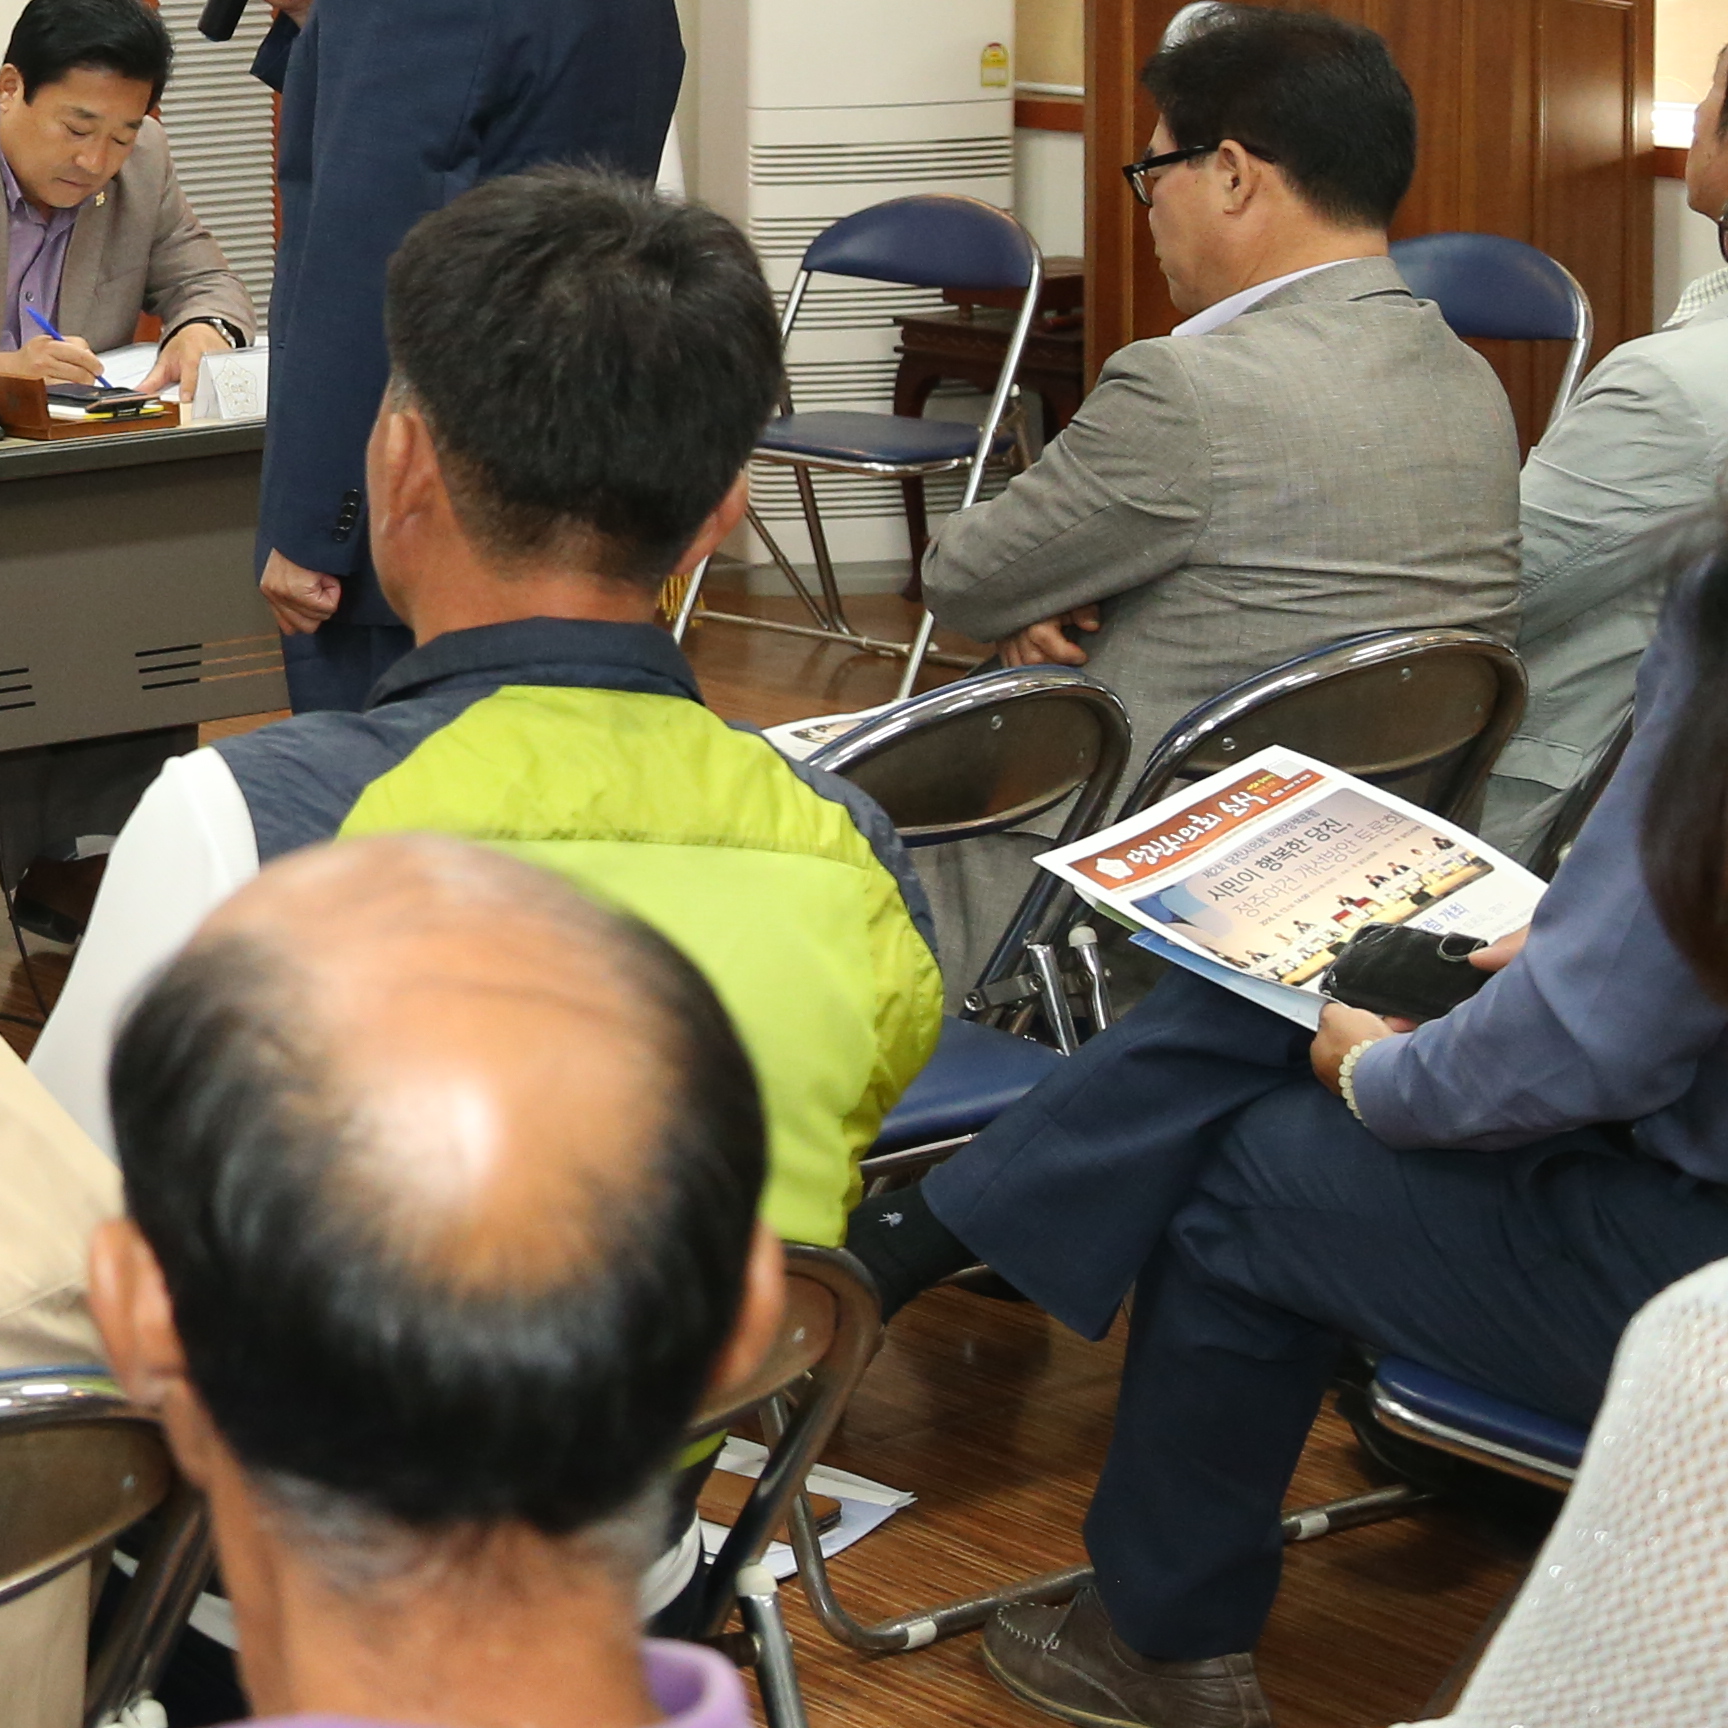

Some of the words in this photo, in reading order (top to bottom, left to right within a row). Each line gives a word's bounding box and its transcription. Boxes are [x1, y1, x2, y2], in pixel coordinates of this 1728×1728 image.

[1206, 867, 1265, 902] 시민이
[1254, 837, 1314, 872] 행복한
[1231, 876, 1304, 919] 정주여건
[1300, 839, 1363, 879] 개선방안
[1354, 811, 1410, 843] 토론회
